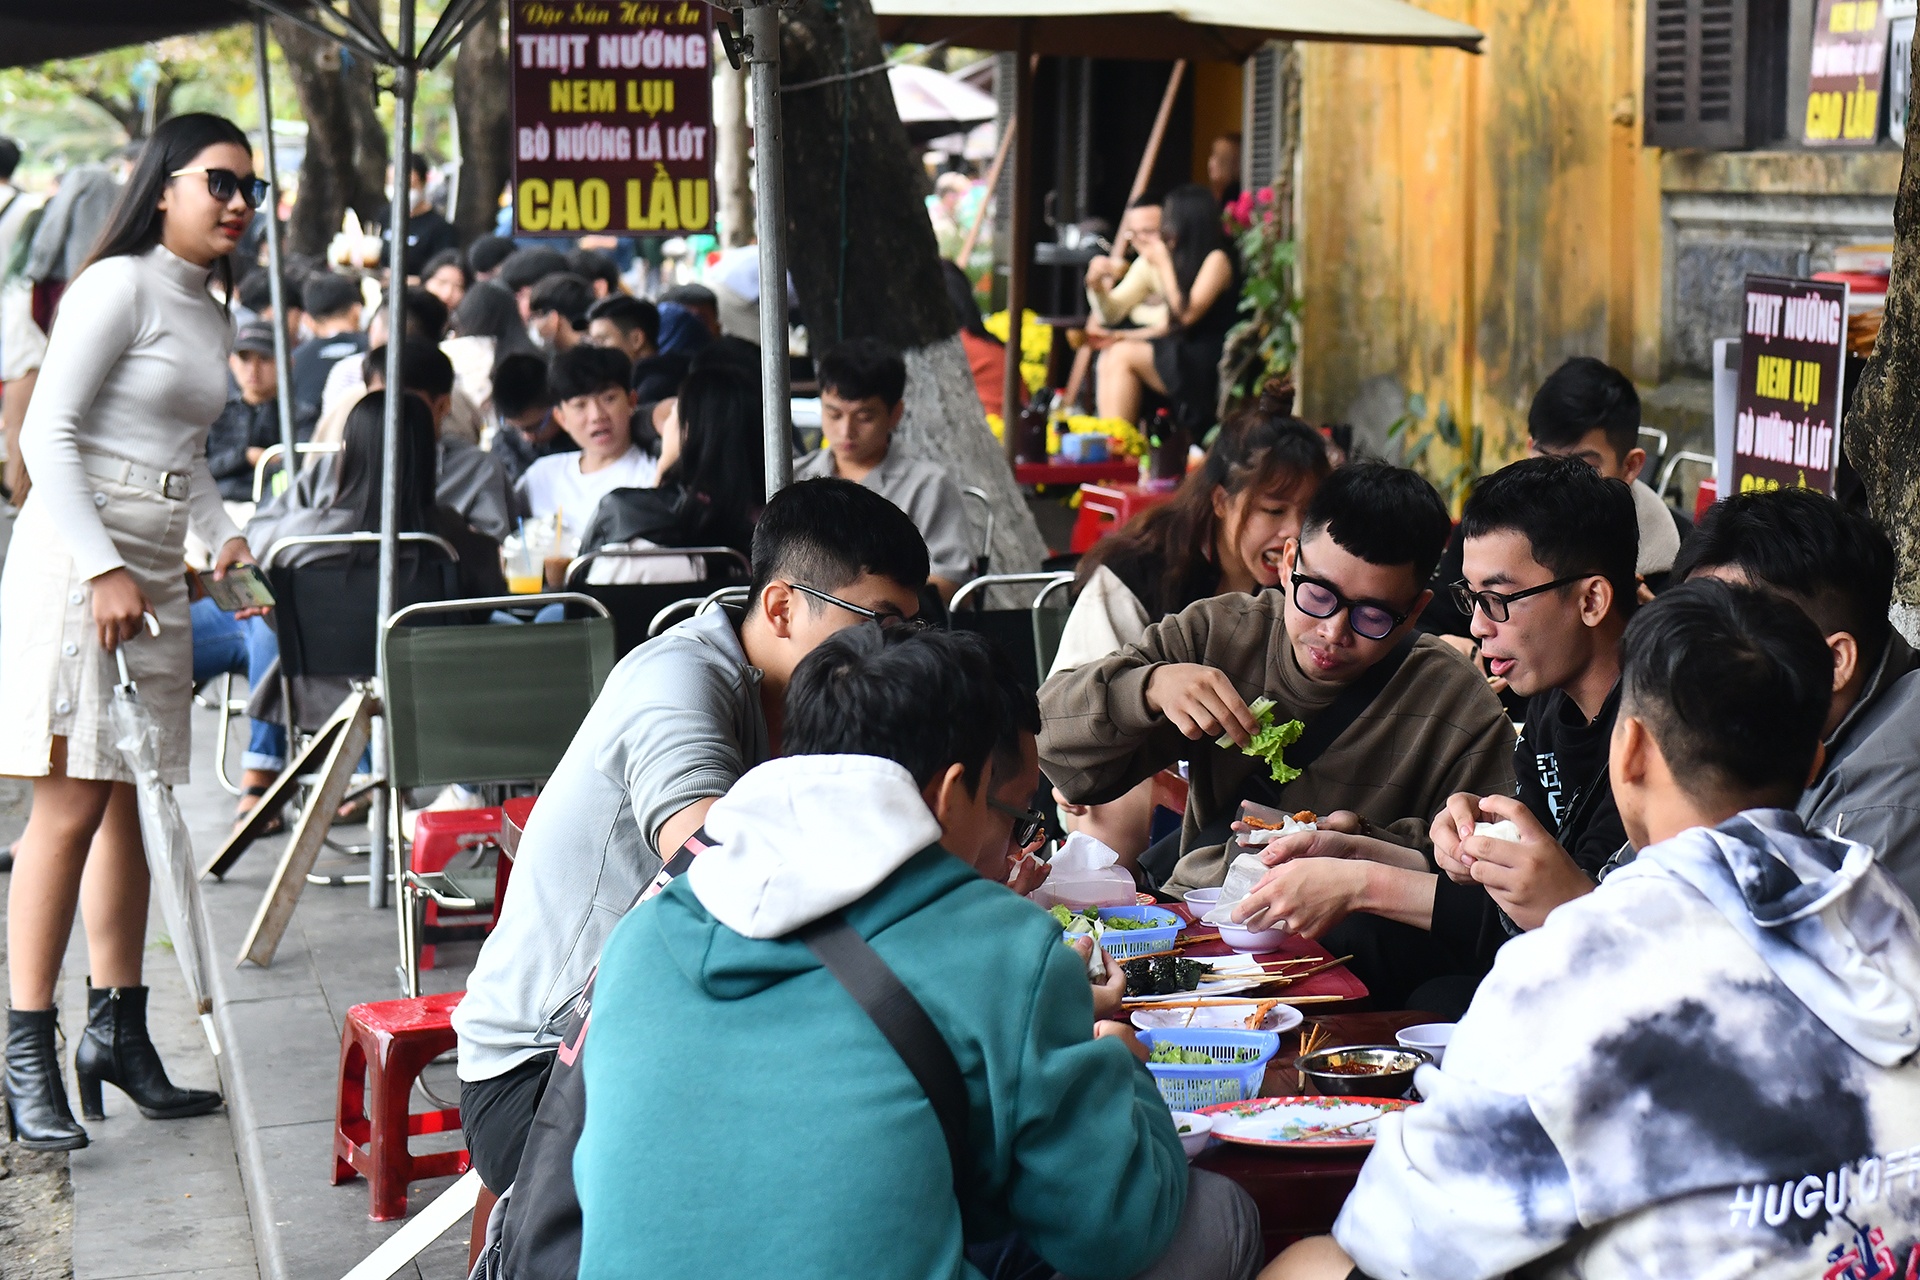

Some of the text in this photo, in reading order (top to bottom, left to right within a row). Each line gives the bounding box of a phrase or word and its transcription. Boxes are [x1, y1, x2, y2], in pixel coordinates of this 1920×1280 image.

[516, 29, 707, 75] THỊT NƯỚNG
[551, 79, 675, 119] NEM LỤI
[518, 121, 549, 161] BÒ
[555, 121, 631, 161] NƯỚNG
[636, 121, 662, 161] LÁ
[518, 161, 709, 231] CAO LẦU
[1747, 291, 1841, 345] THỊT NƯỚNG
[1756, 354, 1821, 412] NEM LỤI
[1794, 417, 1810, 467] LÁ
